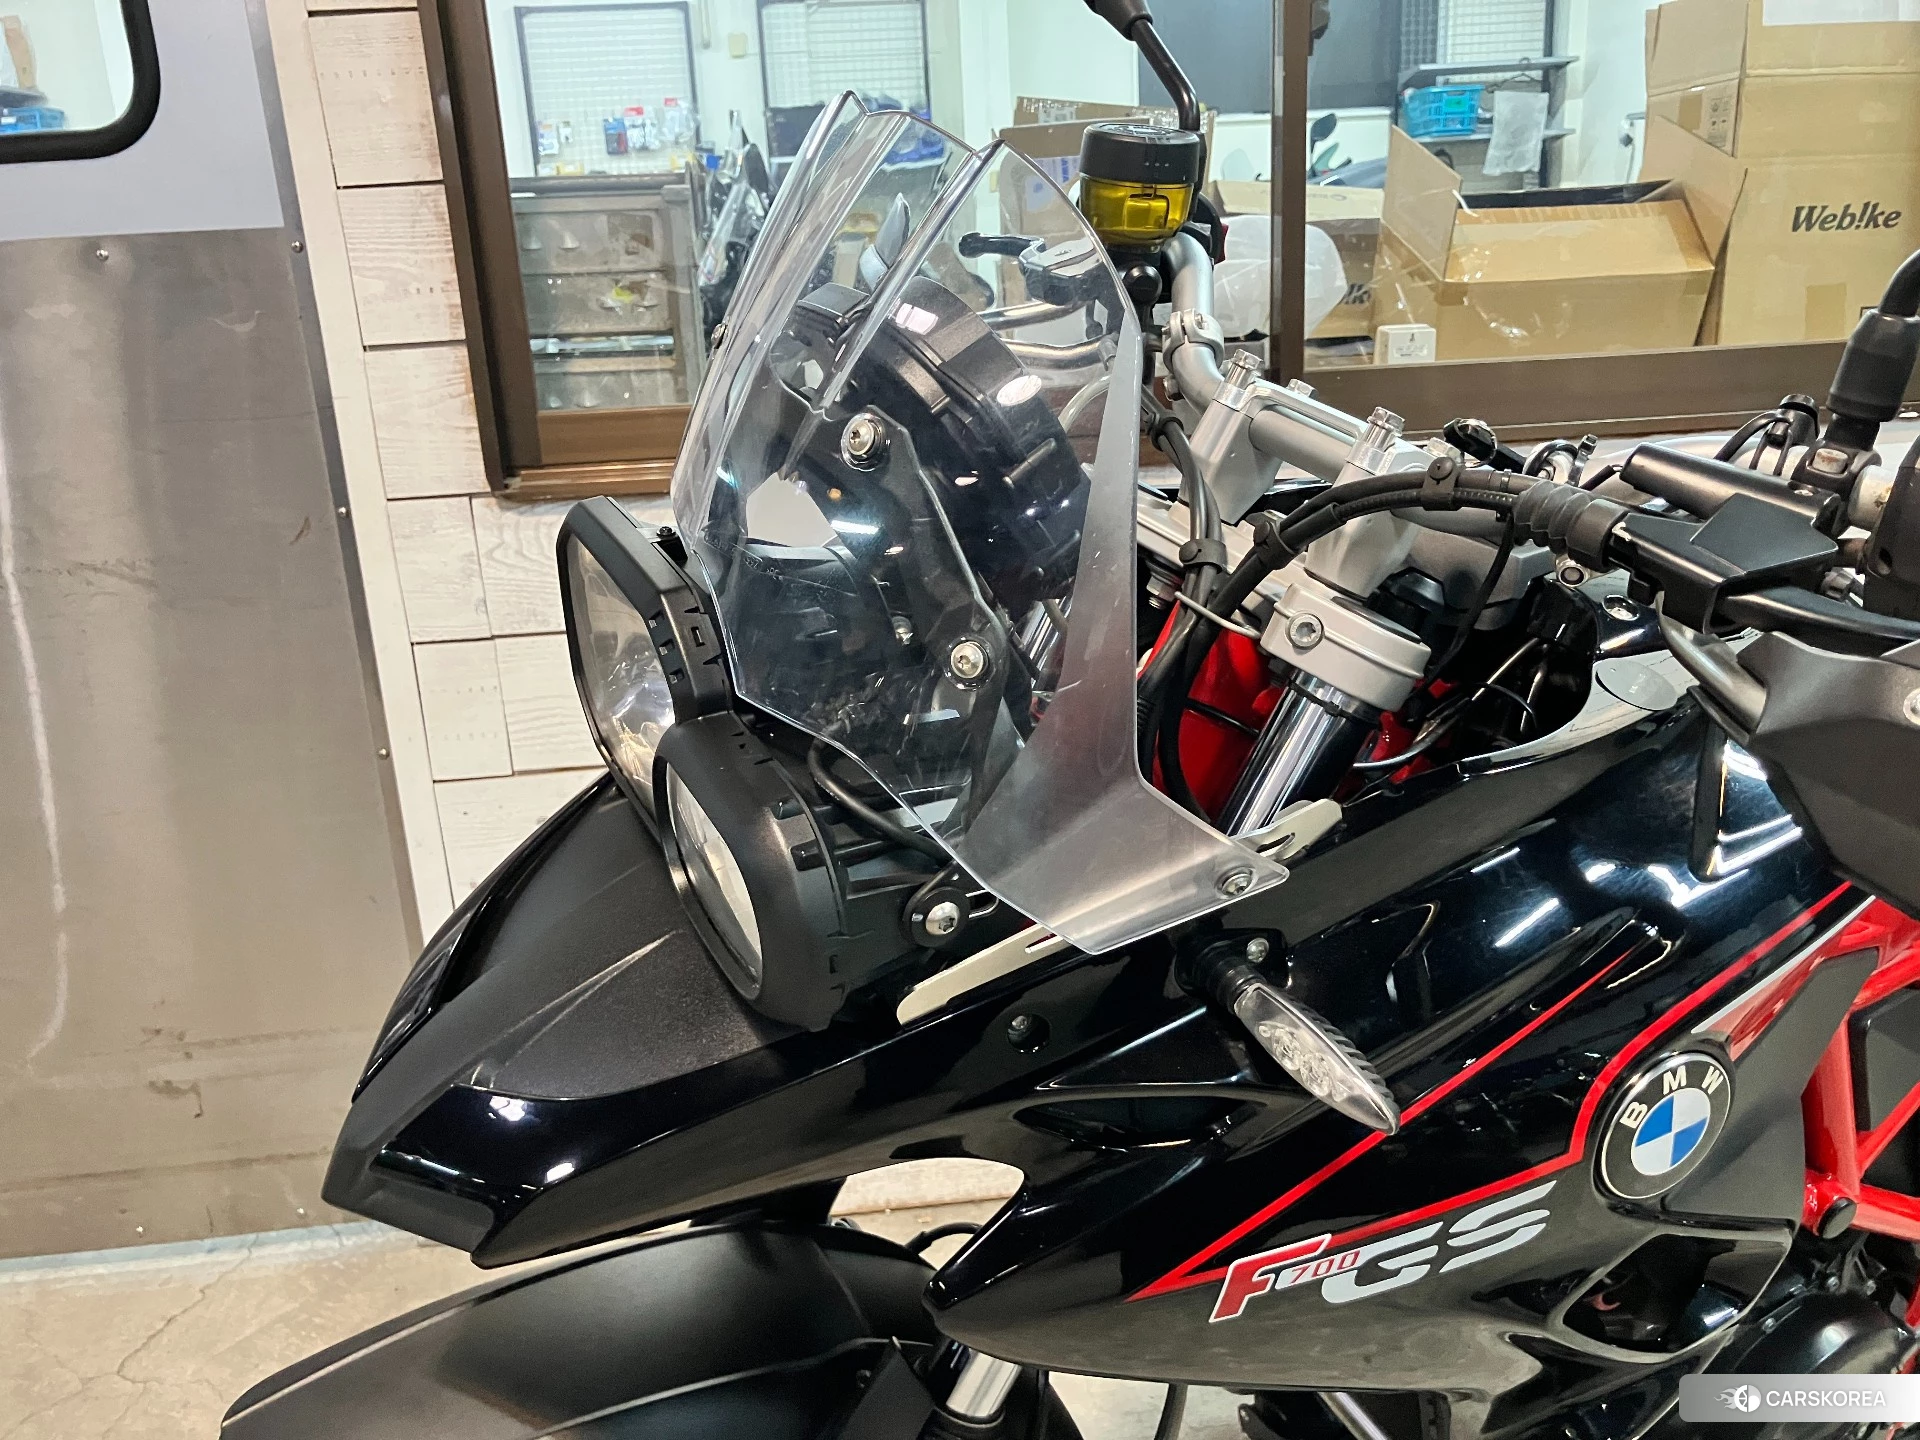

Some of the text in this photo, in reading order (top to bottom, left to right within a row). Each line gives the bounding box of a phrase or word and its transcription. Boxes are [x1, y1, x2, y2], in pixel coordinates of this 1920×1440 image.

[1791, 201, 1902, 232] Web!ke
[1619, 1065, 1724, 1129] BMW
[1321, 1180, 1557, 1304] GS
[1290, 1250, 1361, 1284] 700
